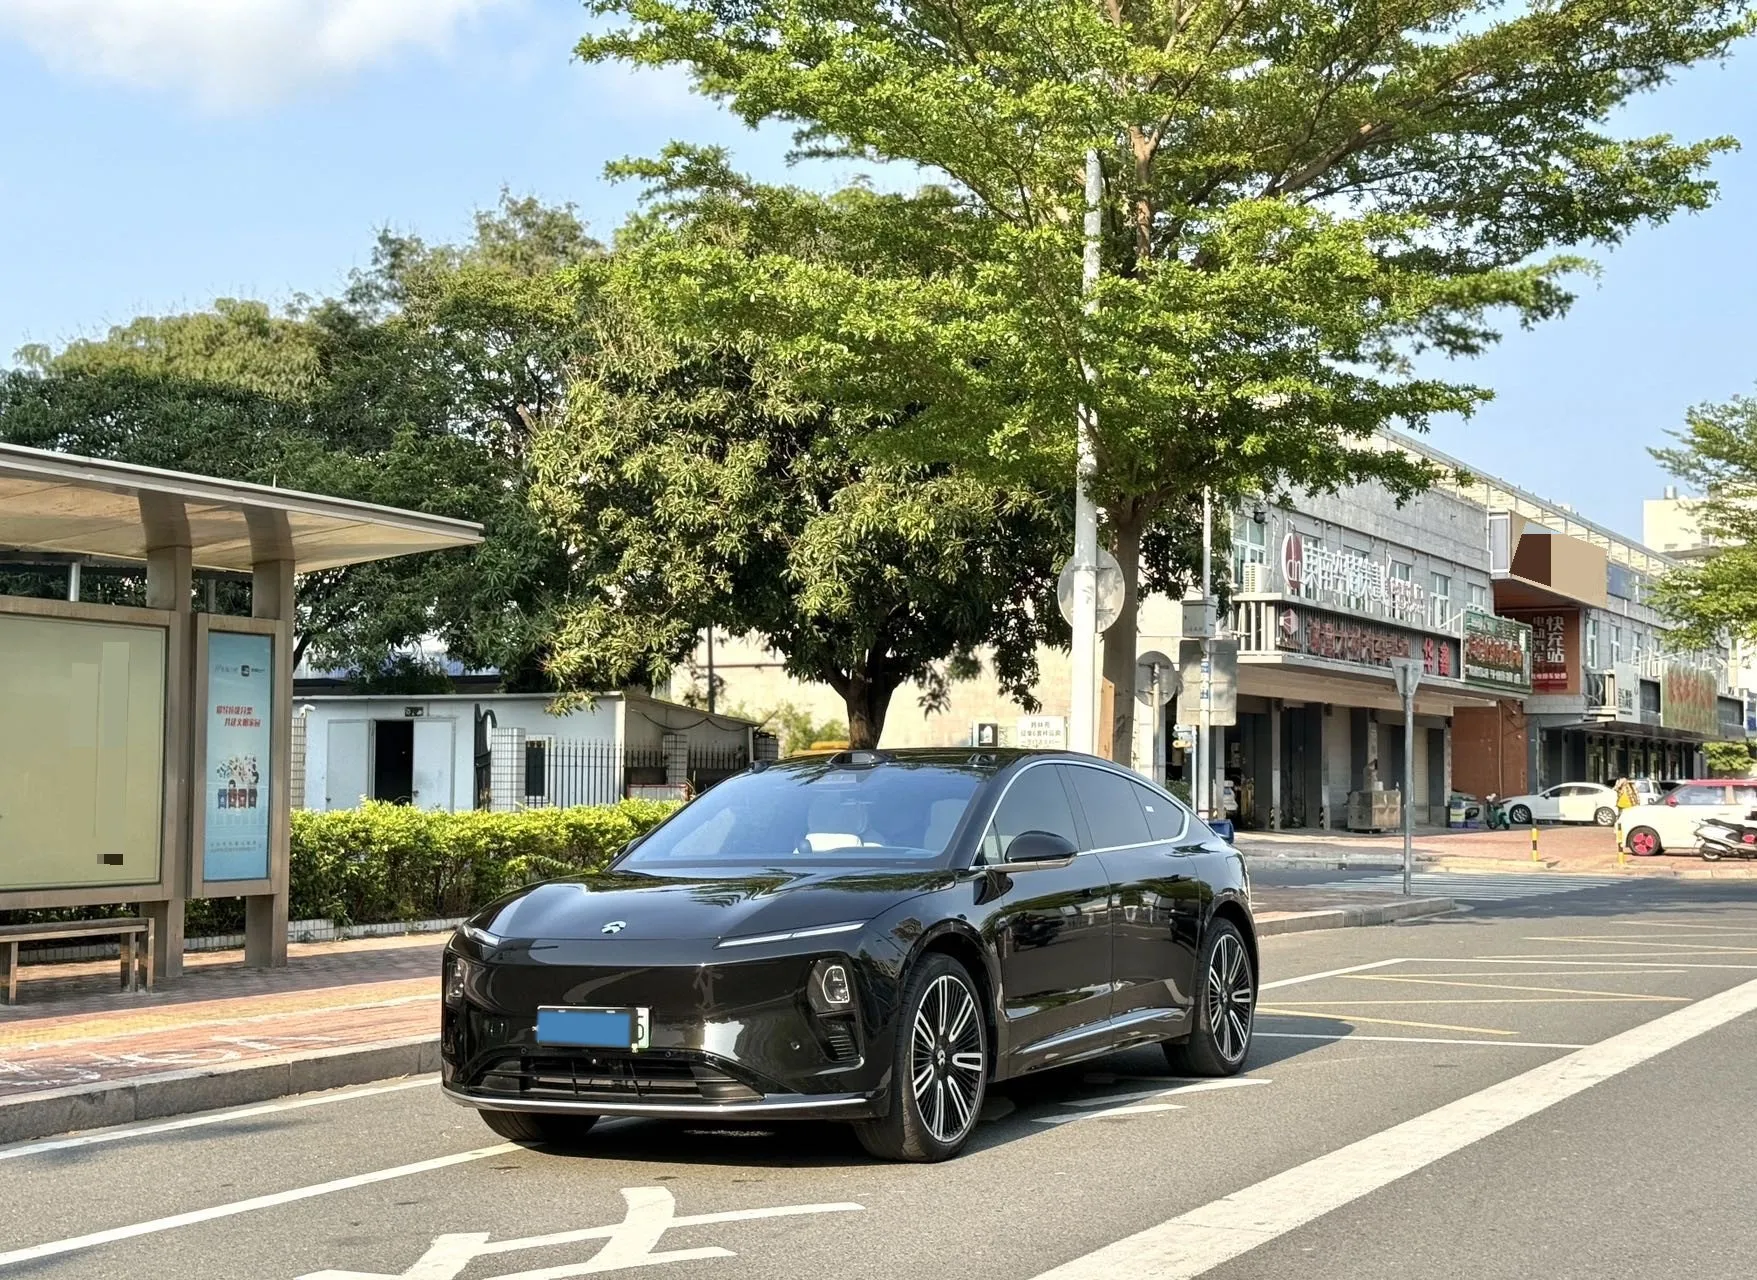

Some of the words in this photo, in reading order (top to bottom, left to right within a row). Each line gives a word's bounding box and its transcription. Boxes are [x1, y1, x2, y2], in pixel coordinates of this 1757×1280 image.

[1533, 616, 1545, 663] 电动汽车
[1546, 615, 1565, 663] 快充站
